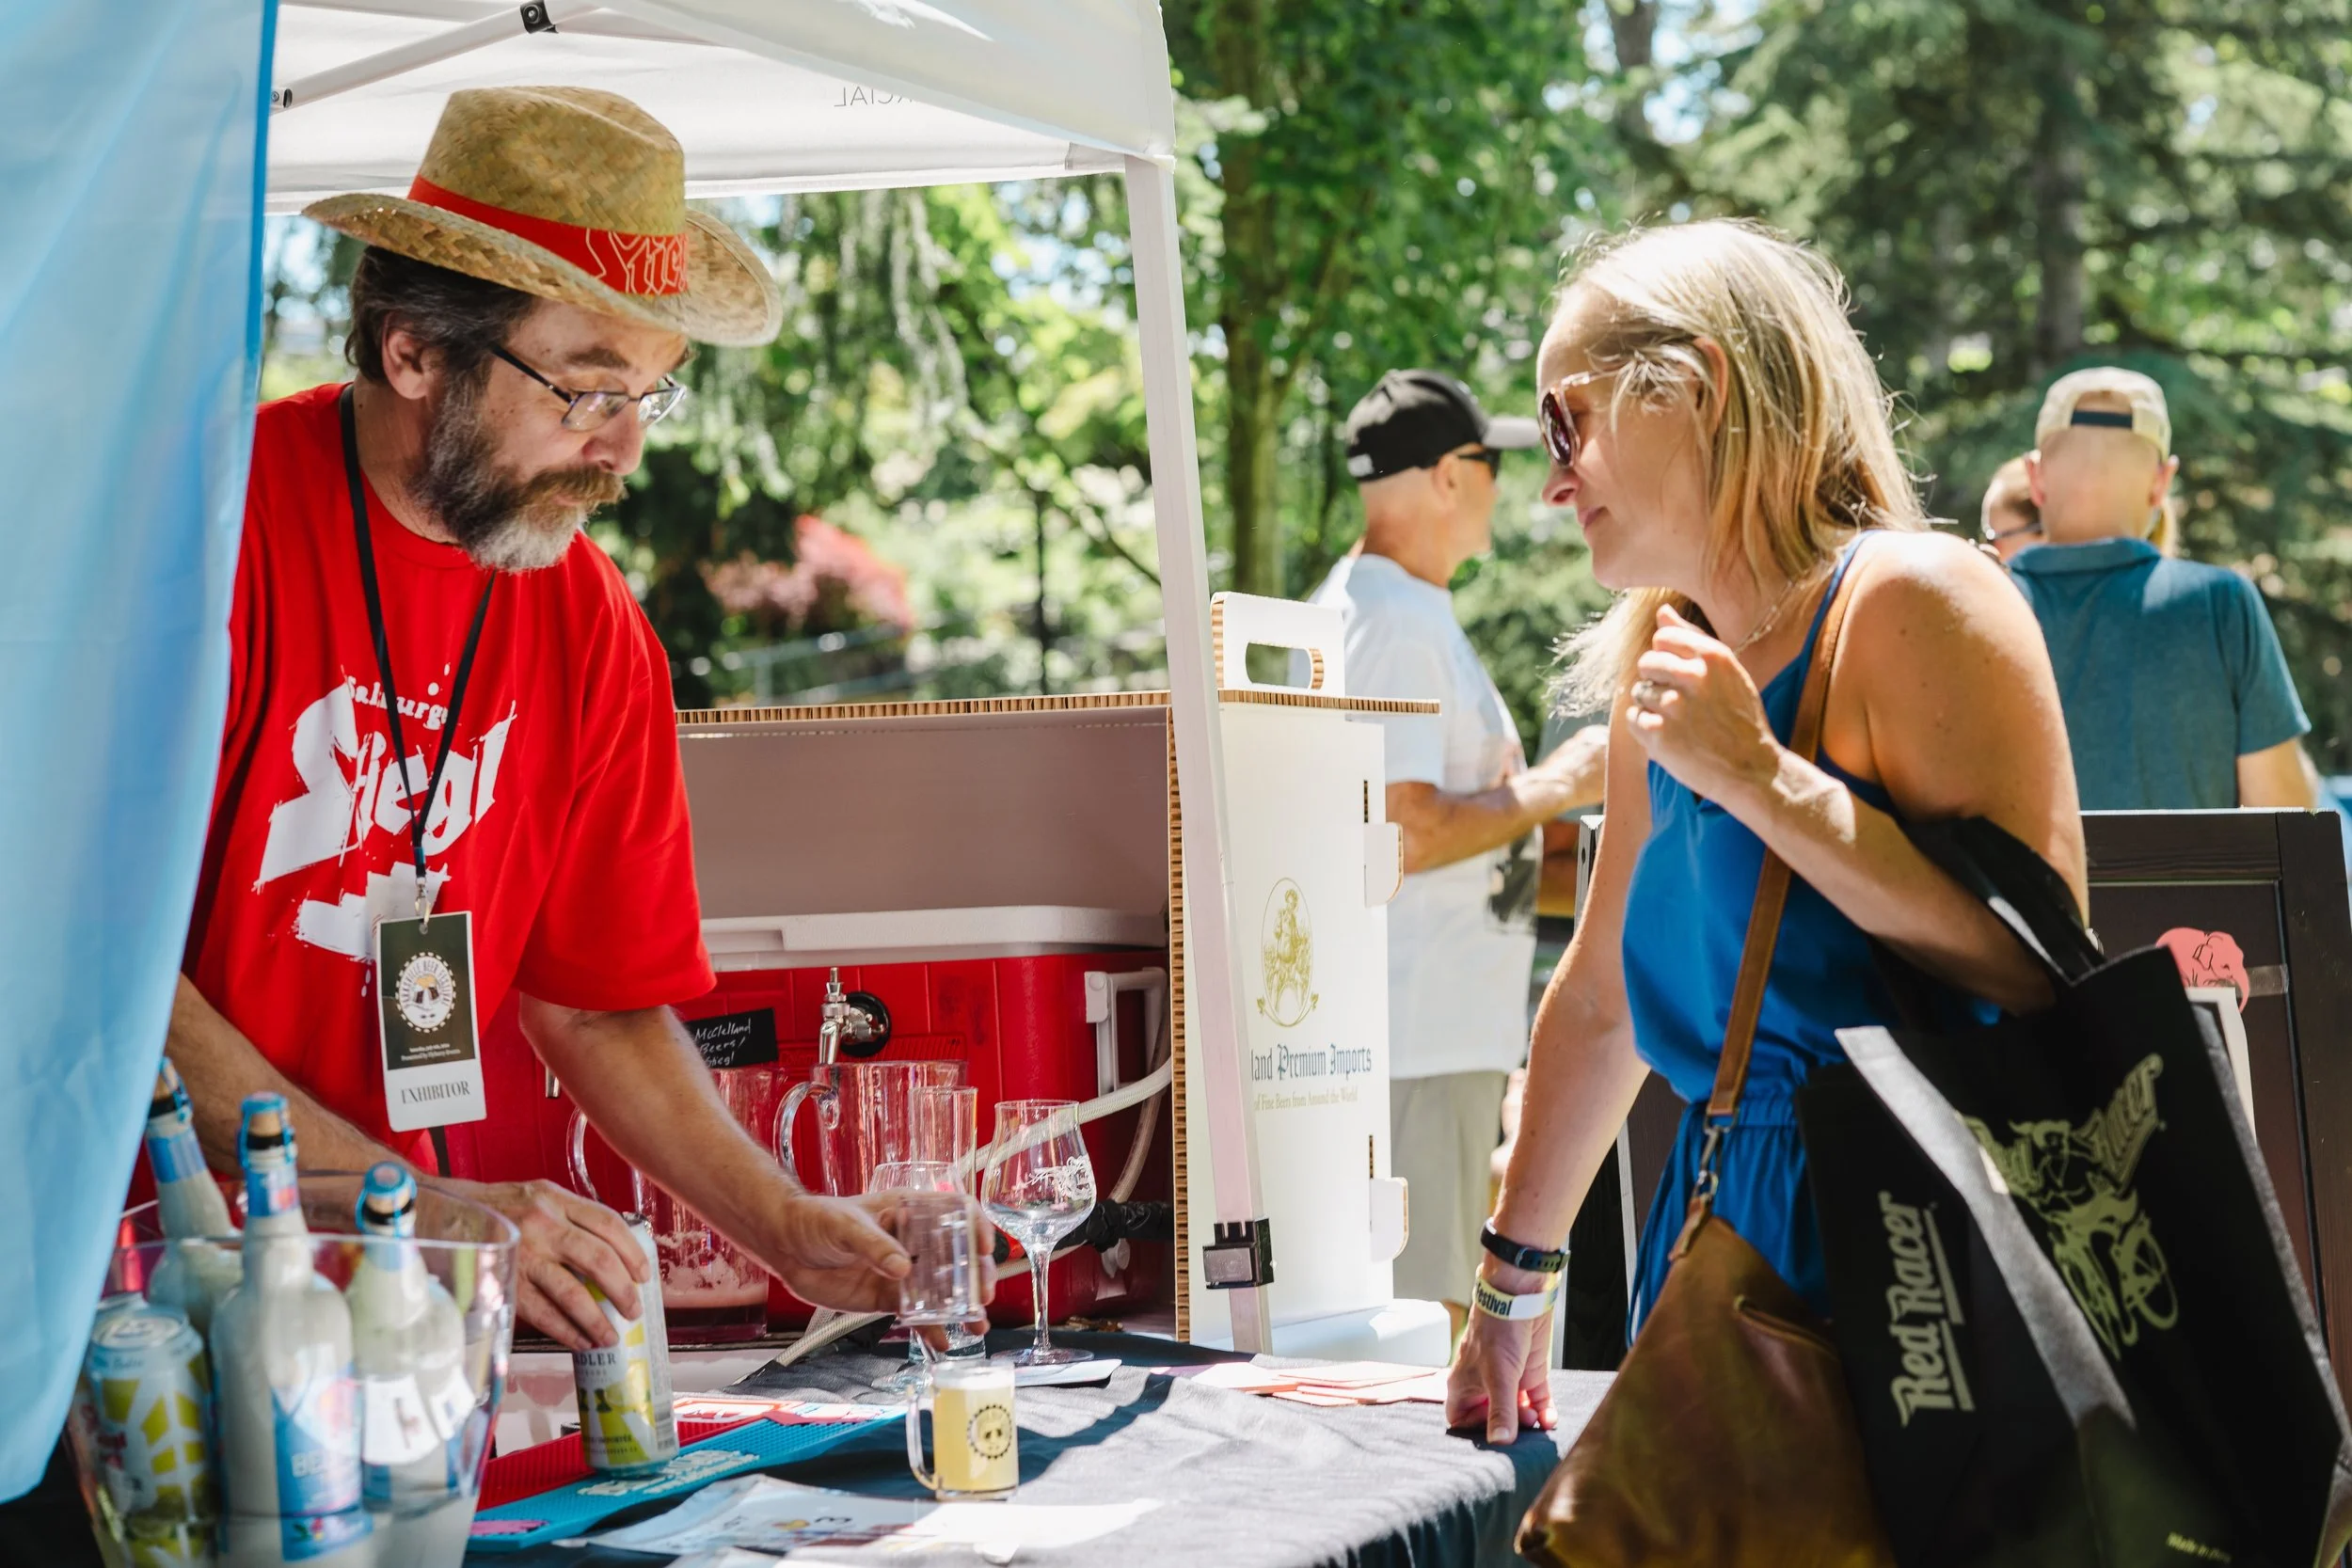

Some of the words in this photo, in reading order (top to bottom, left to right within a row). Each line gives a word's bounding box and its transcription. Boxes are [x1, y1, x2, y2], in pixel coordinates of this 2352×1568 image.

[400, 1080, 471, 1105] EXHIBITOR
[1250, 1048, 1272, 1082] land
[1277, 1043, 1327, 1081] Premium
[1329, 1042, 1372, 1081] Imports
[1878, 1190, 1947, 1323] Racer
[1889, 1319, 1956, 1428] Red
